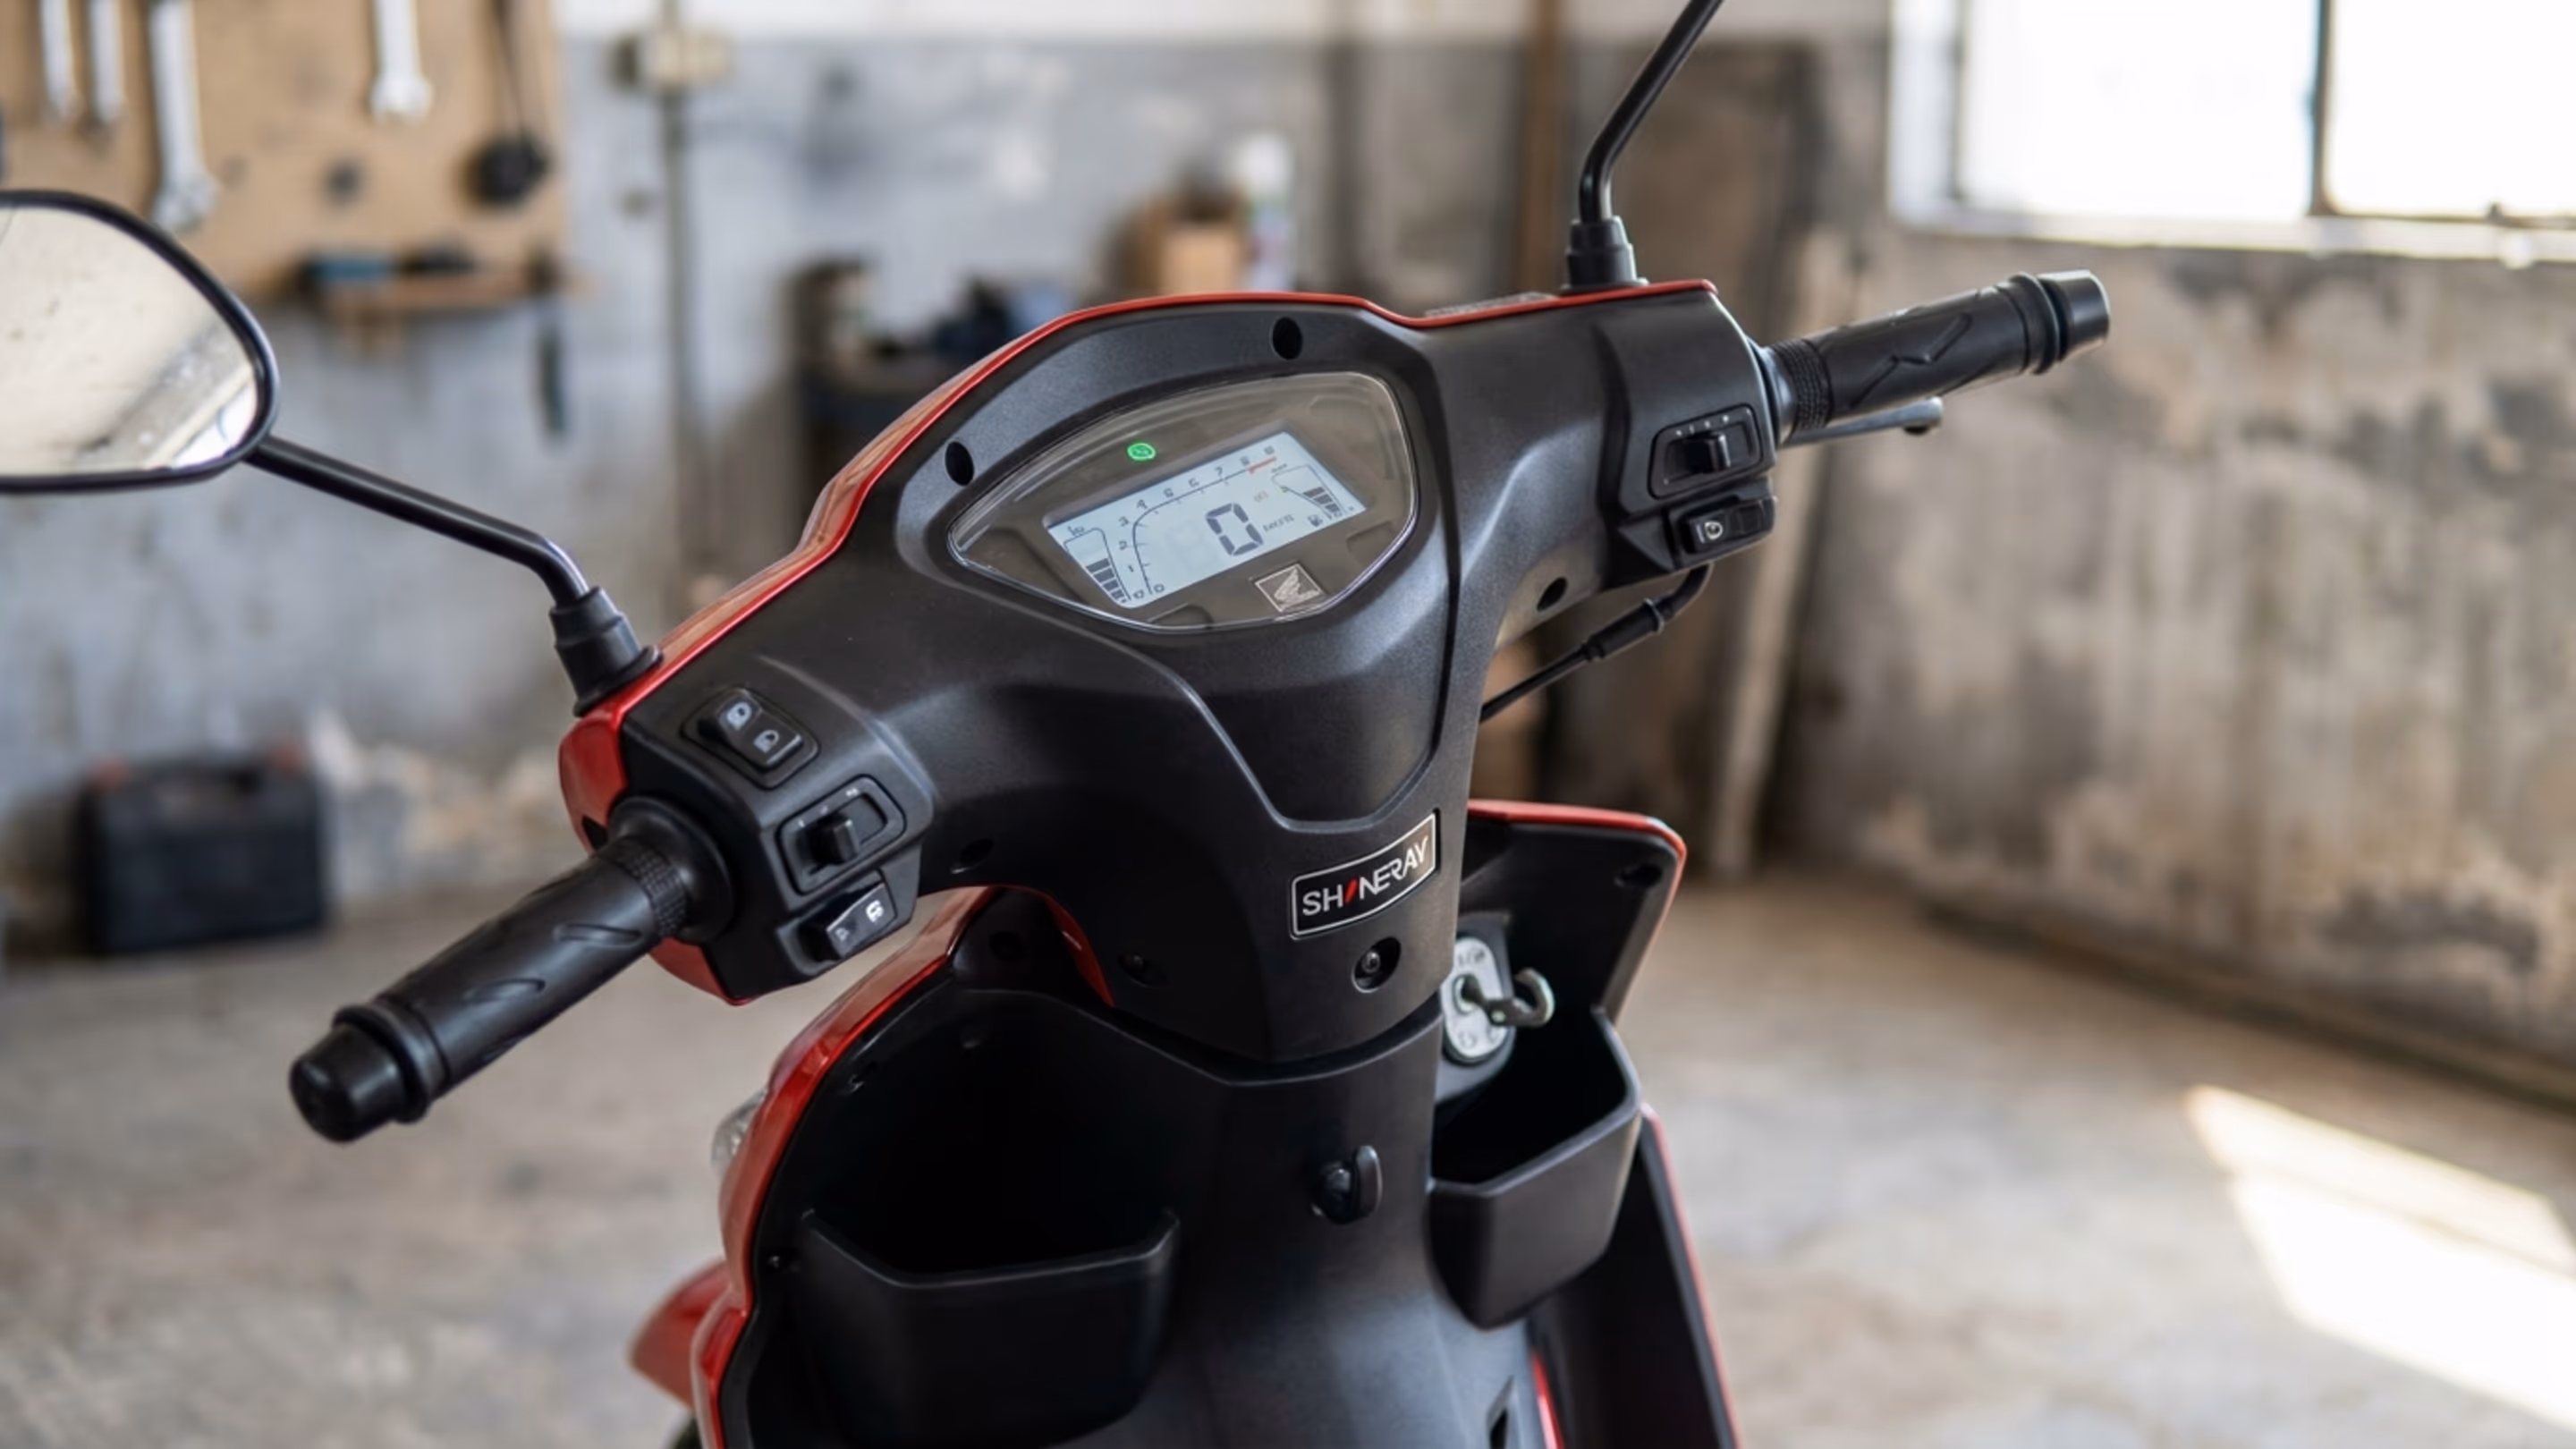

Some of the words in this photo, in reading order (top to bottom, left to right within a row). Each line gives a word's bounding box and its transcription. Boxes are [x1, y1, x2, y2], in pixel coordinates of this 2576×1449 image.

[1215, 464, 1224, 478] 7
[1205, 502, 1264, 555] 0
[1302, 835, 1428, 916] SHINERAY
